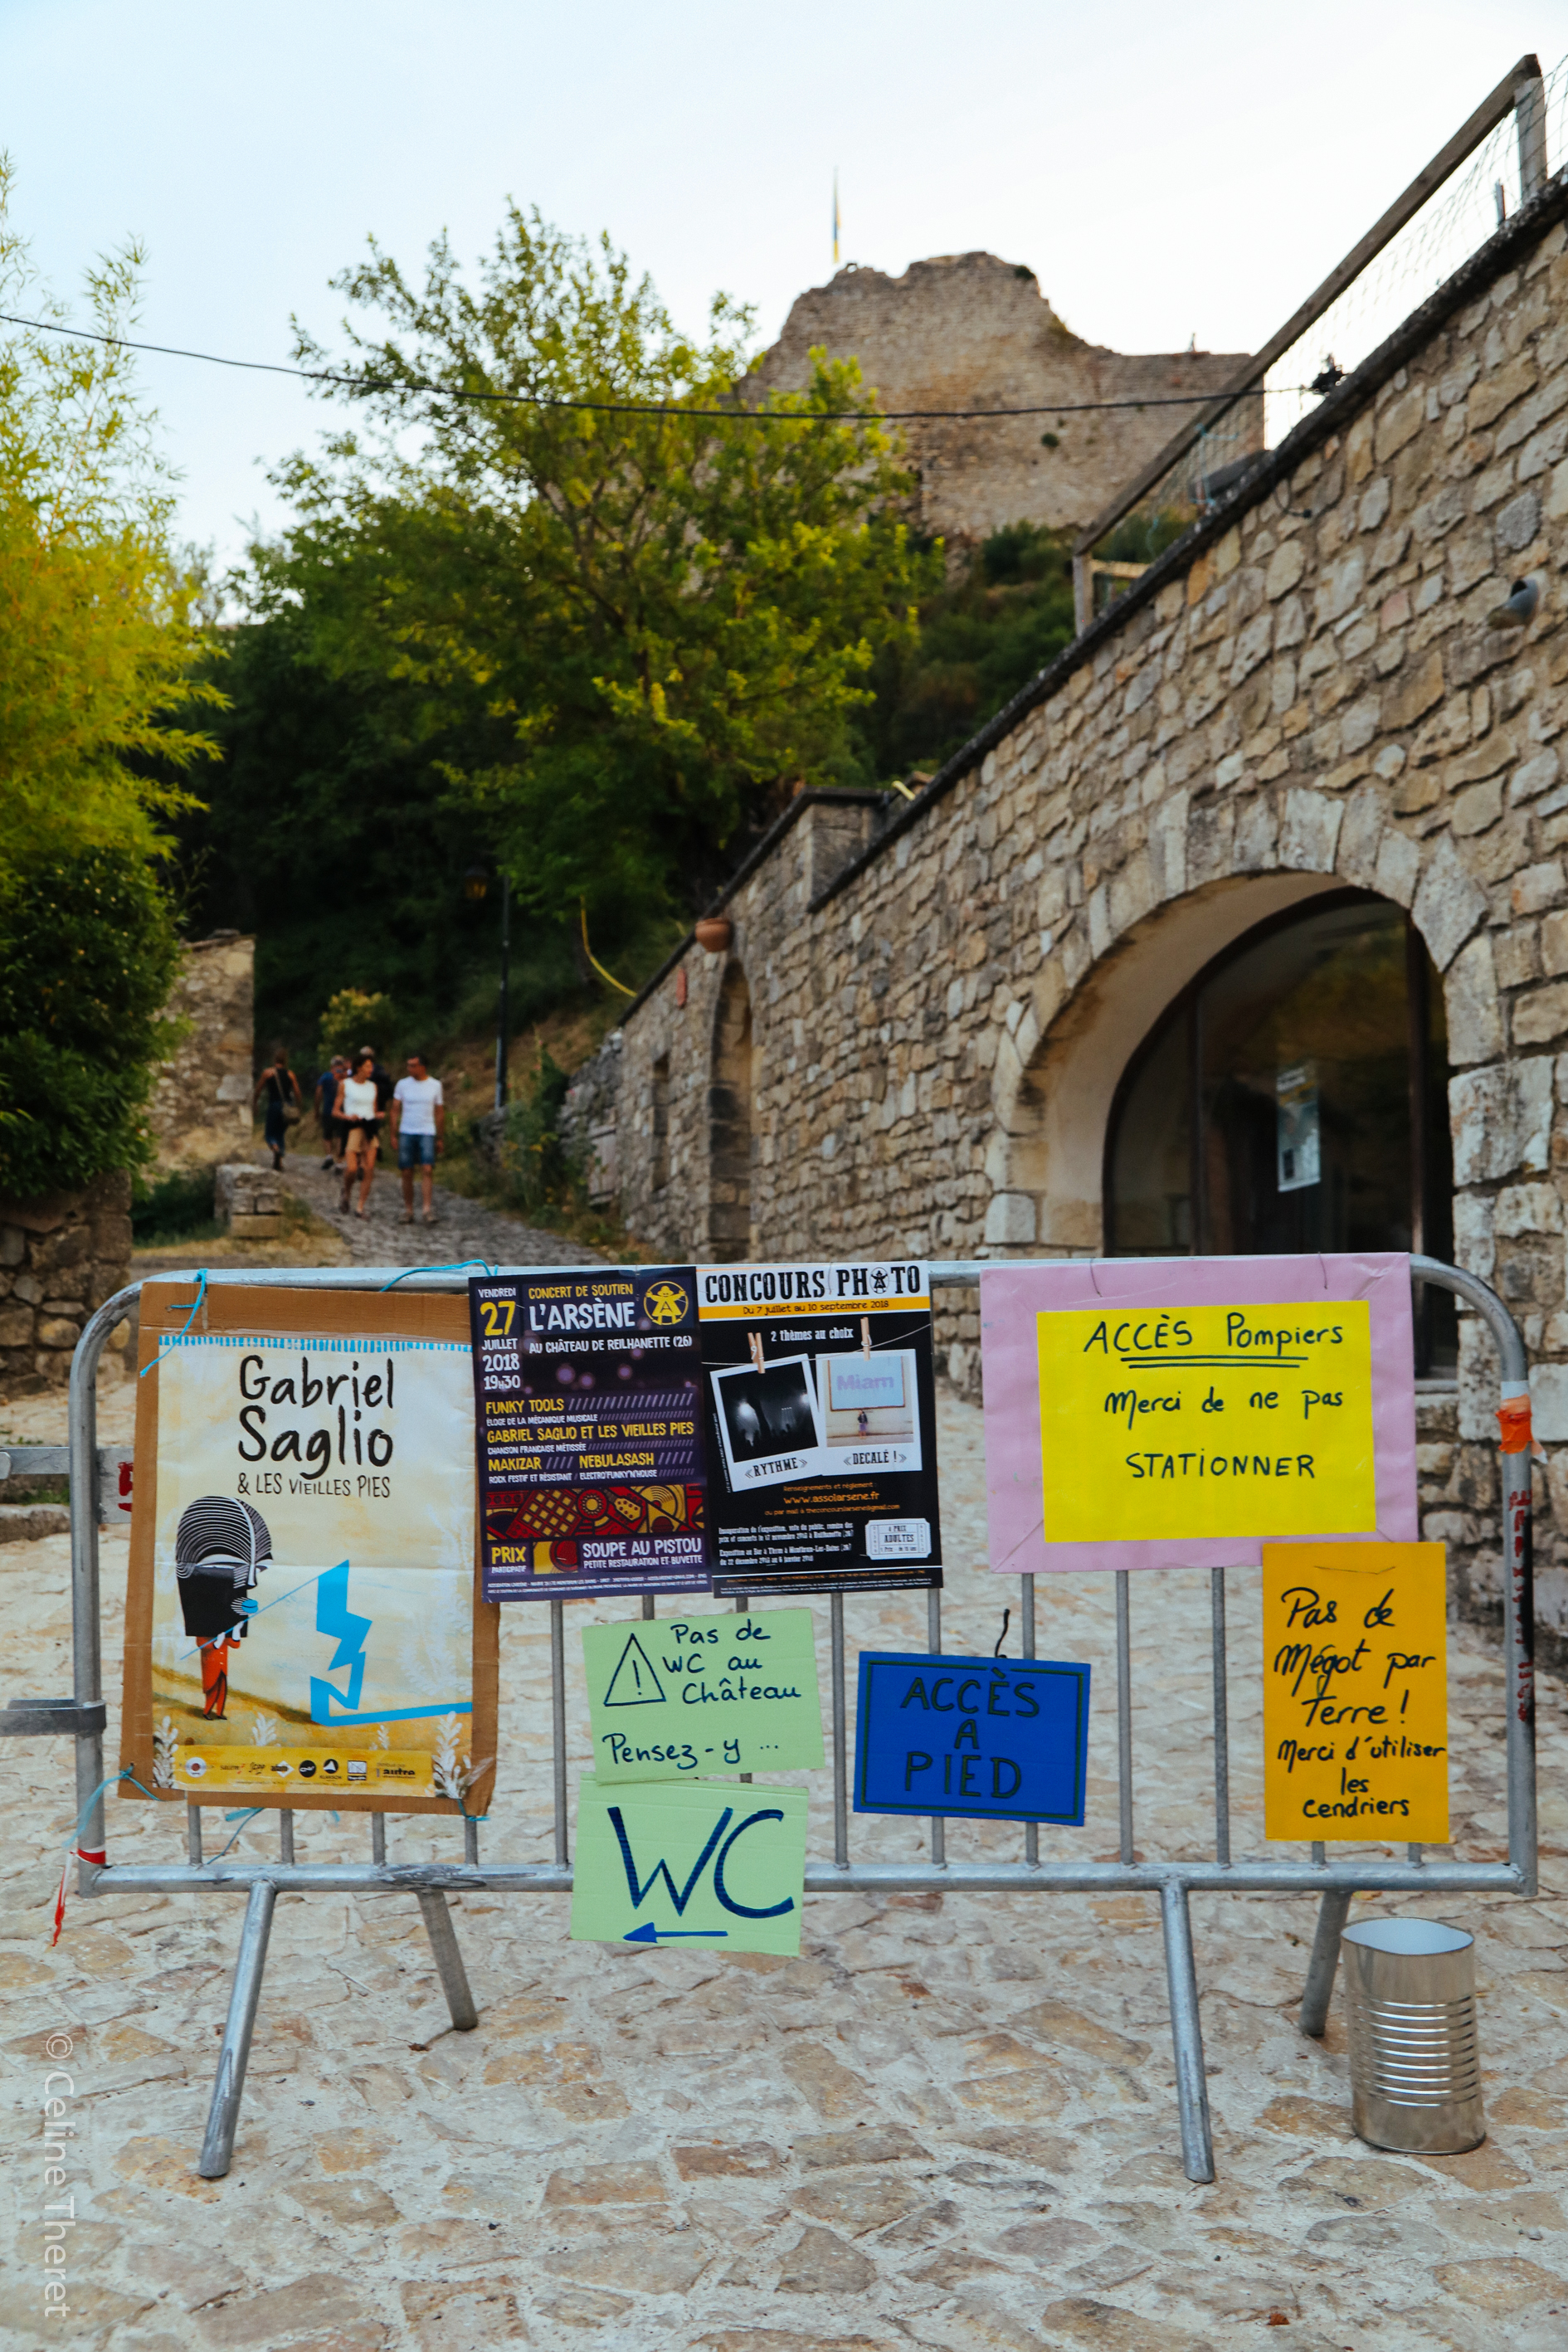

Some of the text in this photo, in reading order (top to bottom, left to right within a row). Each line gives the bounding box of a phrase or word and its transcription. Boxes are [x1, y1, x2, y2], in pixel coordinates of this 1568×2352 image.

[478, 1288, 516, 1298] VENDREDI
[528, 1283, 633, 1299] CONCERT DE SOUTIEN
[706, 1270, 825, 1303] CONCOURS
[480, 1301, 516, 1337] 27
[528, 1298, 635, 1331] L'ARSÈNE
[743, 1306, 754, 1315] Du
[764, 1304, 791, 1316] juillet
[808, 1303, 817, 1312] 10
[820, 1300, 868, 1312] septembre
[870, 1300, 889, 1308] 2018
[481, 1338, 518, 1351] JUILLET
[528, 1336, 693, 1354] AU CHÂTEAU DE REILHANETTE (26)
[771, 1327, 854, 1342] 2 thèmes au choix
[1083, 1312, 1343, 1356] ACCÈS Pompiers
[482, 1353, 520, 1372] 2018
[240, 1355, 393, 1409] Gabriel
[836, 1374, 894, 1390] Miam
[485, 1398, 564, 1415] FUNKY TOOLS
[1104, 1385, 1343, 1430] Merci de ne pas
[567, 1414, 598, 1423] MUSICALE
[238, 1404, 393, 1480] Saglio
[487, 1421, 694, 1444] GABRIEL SAGLIO ET LES VIEILLES PIES
[488, 1446, 519, 1455] CHANSON
[488, 1452, 655, 1472] MAKIZAR NEBULASASH
[237, 1473, 390, 1498] & LES VIEILLES PIES
[489, 1475, 507, 1484] ROCK
[508, 1474, 528, 1483] FESTIF
[783, 1492, 879, 1504] www.assolarsene.fr
[582, 1537, 702, 1558] SOUPE AU PISTOU
[884, 1534, 914, 1543] ADULTES
[491, 1546, 527, 1565] PRIX
[583, 1560, 607, 1569] PETITE
[608, 1557, 660, 1567] RESTAURATION
[1281, 1586, 1395, 1629] Pas de
[670, 1619, 771, 1644] Pas de
[662, 1653, 762, 1673] WC au
[1273, 1639, 1437, 1698] Mégot par
[682, 1676, 801, 1704] Château
[900, 1667, 1040, 1718] ACCÈS
[954, 1719, 980, 1750] A
[1278, 1739, 1335, 1773] Merci
[904, 1751, 1022, 1799] PIED
[1341, 1767, 1369, 1795] les
[607, 1806, 795, 1919] WC
